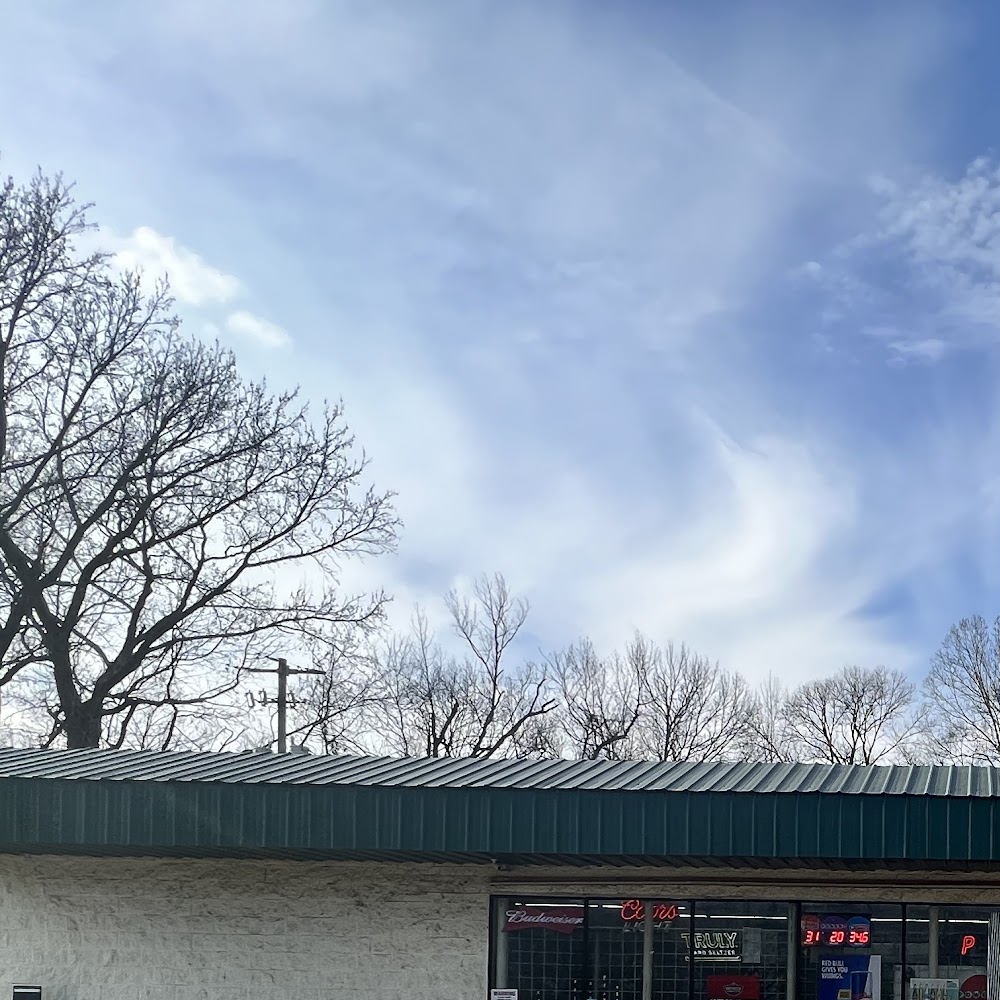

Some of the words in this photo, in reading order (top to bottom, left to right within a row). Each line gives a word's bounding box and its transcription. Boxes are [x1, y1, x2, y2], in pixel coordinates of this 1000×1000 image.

[506, 910, 584, 925] Budweiser
[806, 931, 820, 942] 31
[830, 931, 844, 943] 20
[849, 931, 869, 943] 346
